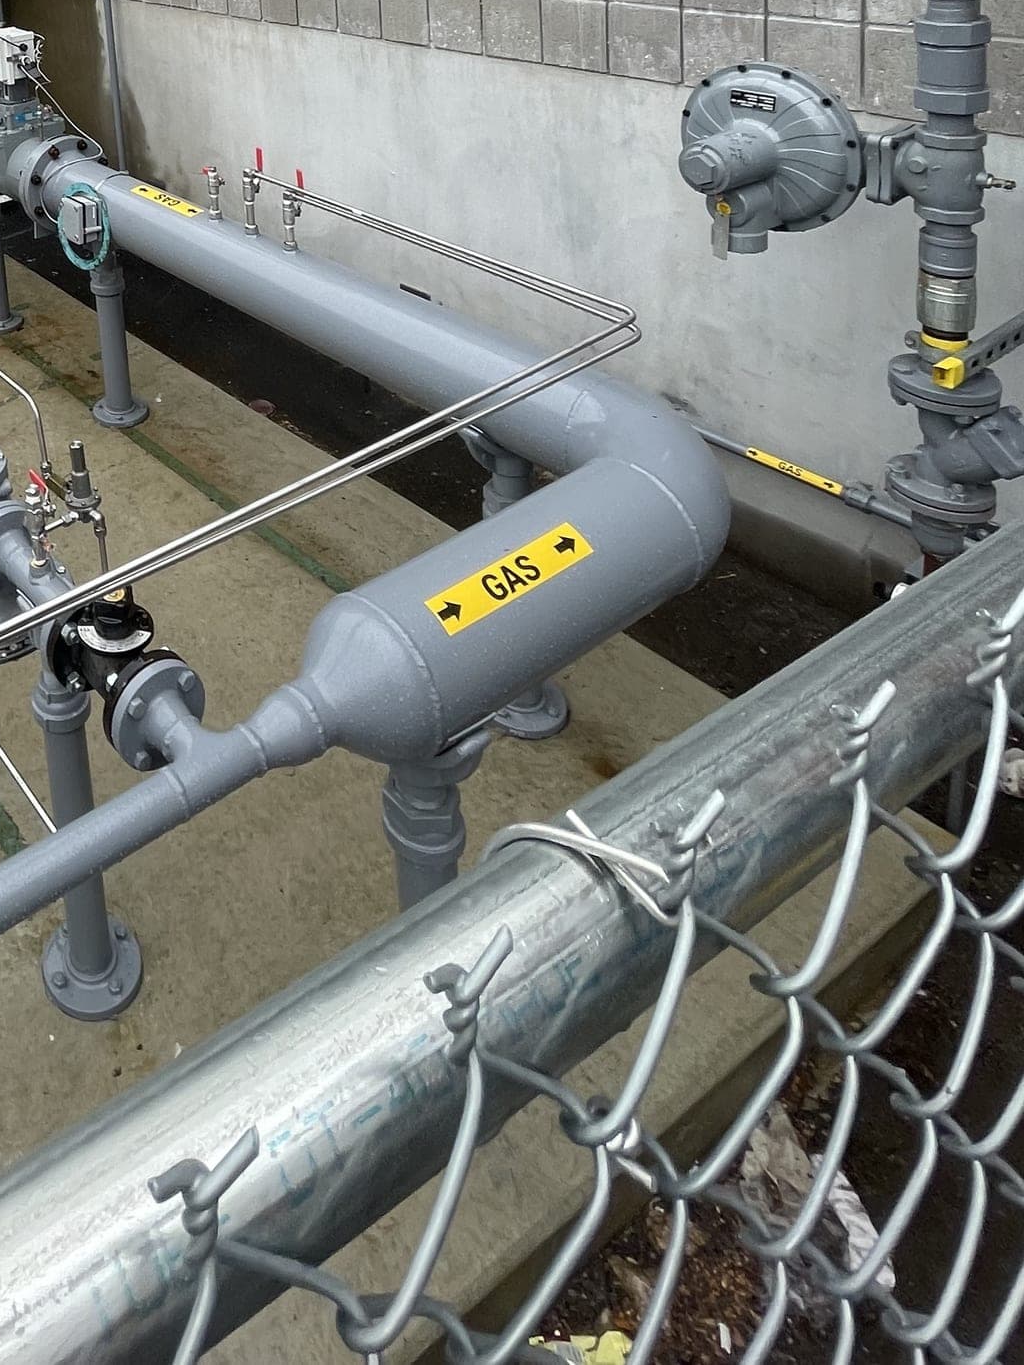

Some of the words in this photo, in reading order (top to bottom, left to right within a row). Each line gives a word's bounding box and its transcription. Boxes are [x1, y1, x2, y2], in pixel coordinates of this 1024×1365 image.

[154, 194, 181, 206] GAS
[777, 461, 804, 478] GAS
[481, 555, 542, 602] GAS
